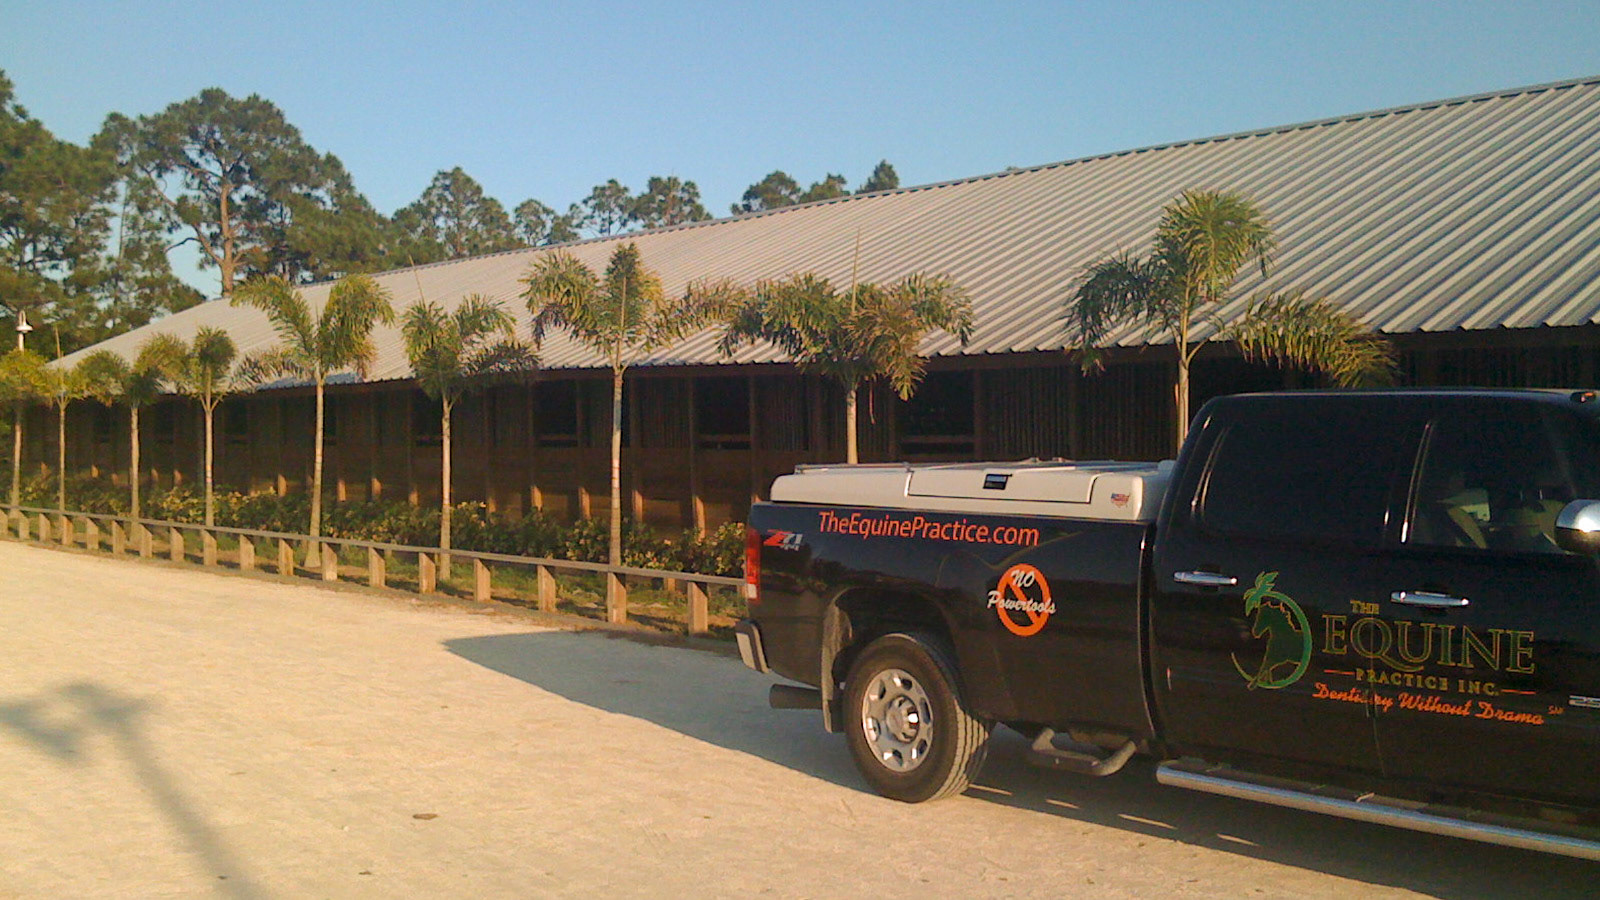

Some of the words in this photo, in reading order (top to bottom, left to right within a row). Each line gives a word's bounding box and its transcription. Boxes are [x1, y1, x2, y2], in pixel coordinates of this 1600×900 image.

[818, 510, 1040, 546] TheEquinePractice.com
[987, 590, 1057, 614] Powertools
[1350, 600, 1380, 614] THE
[1322, 614, 1536, 674] EQUINE
[1355, 668, 1449, 691] PRACTICE
[1458, 679, 1500, 696] INC.
[1312, 681, 1394, 712] Dentiry
[1398, 692, 1472, 716] Without
[1474, 701, 1544, 725] Drama
